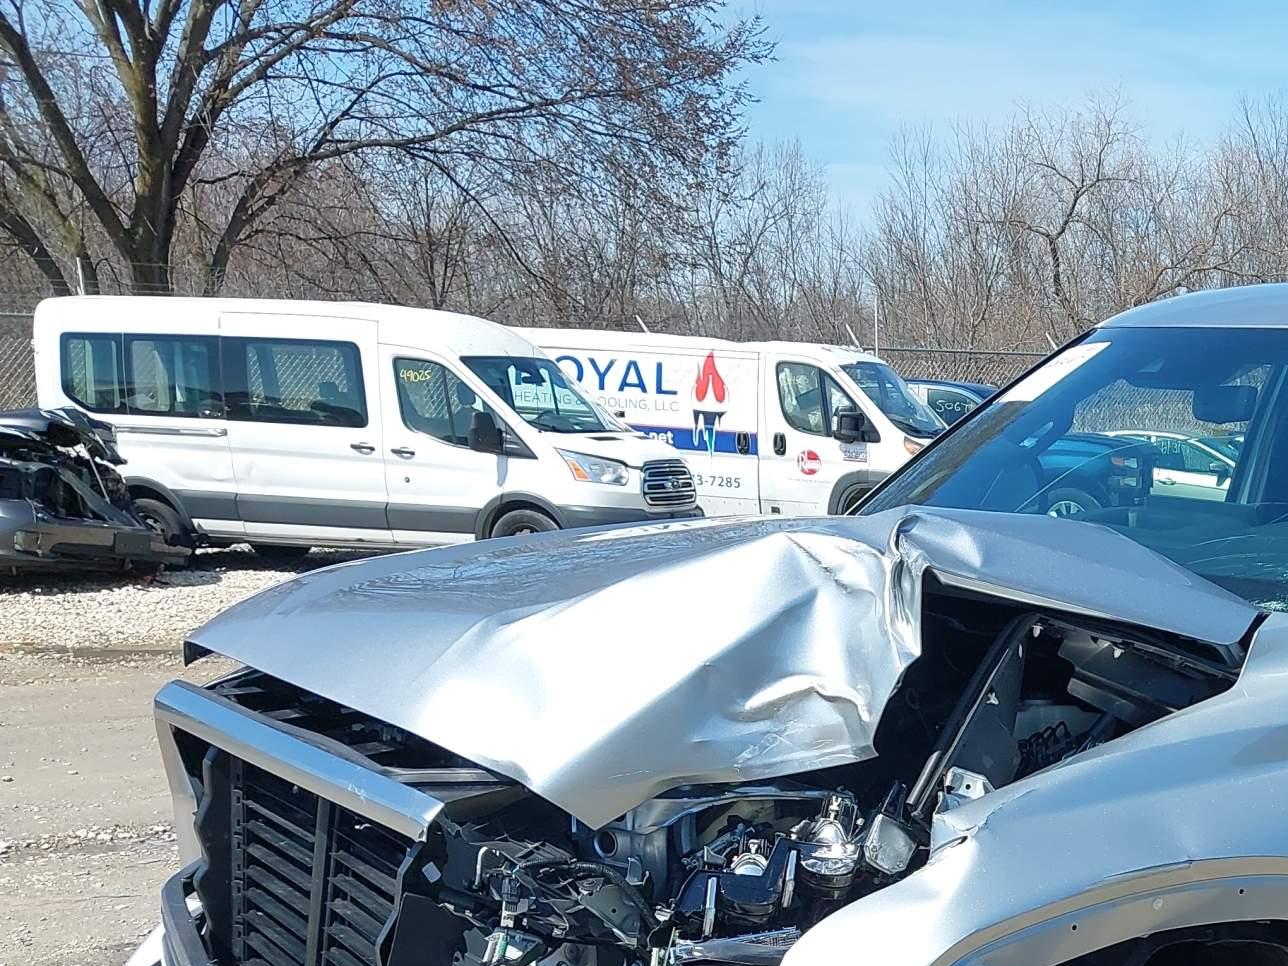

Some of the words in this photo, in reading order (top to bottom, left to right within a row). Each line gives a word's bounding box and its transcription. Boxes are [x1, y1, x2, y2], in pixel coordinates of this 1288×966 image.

[400, 369, 431, 382] 49025
[654, 400, 680, 412] LLC
[692, 473, 741, 489] 3-7285
